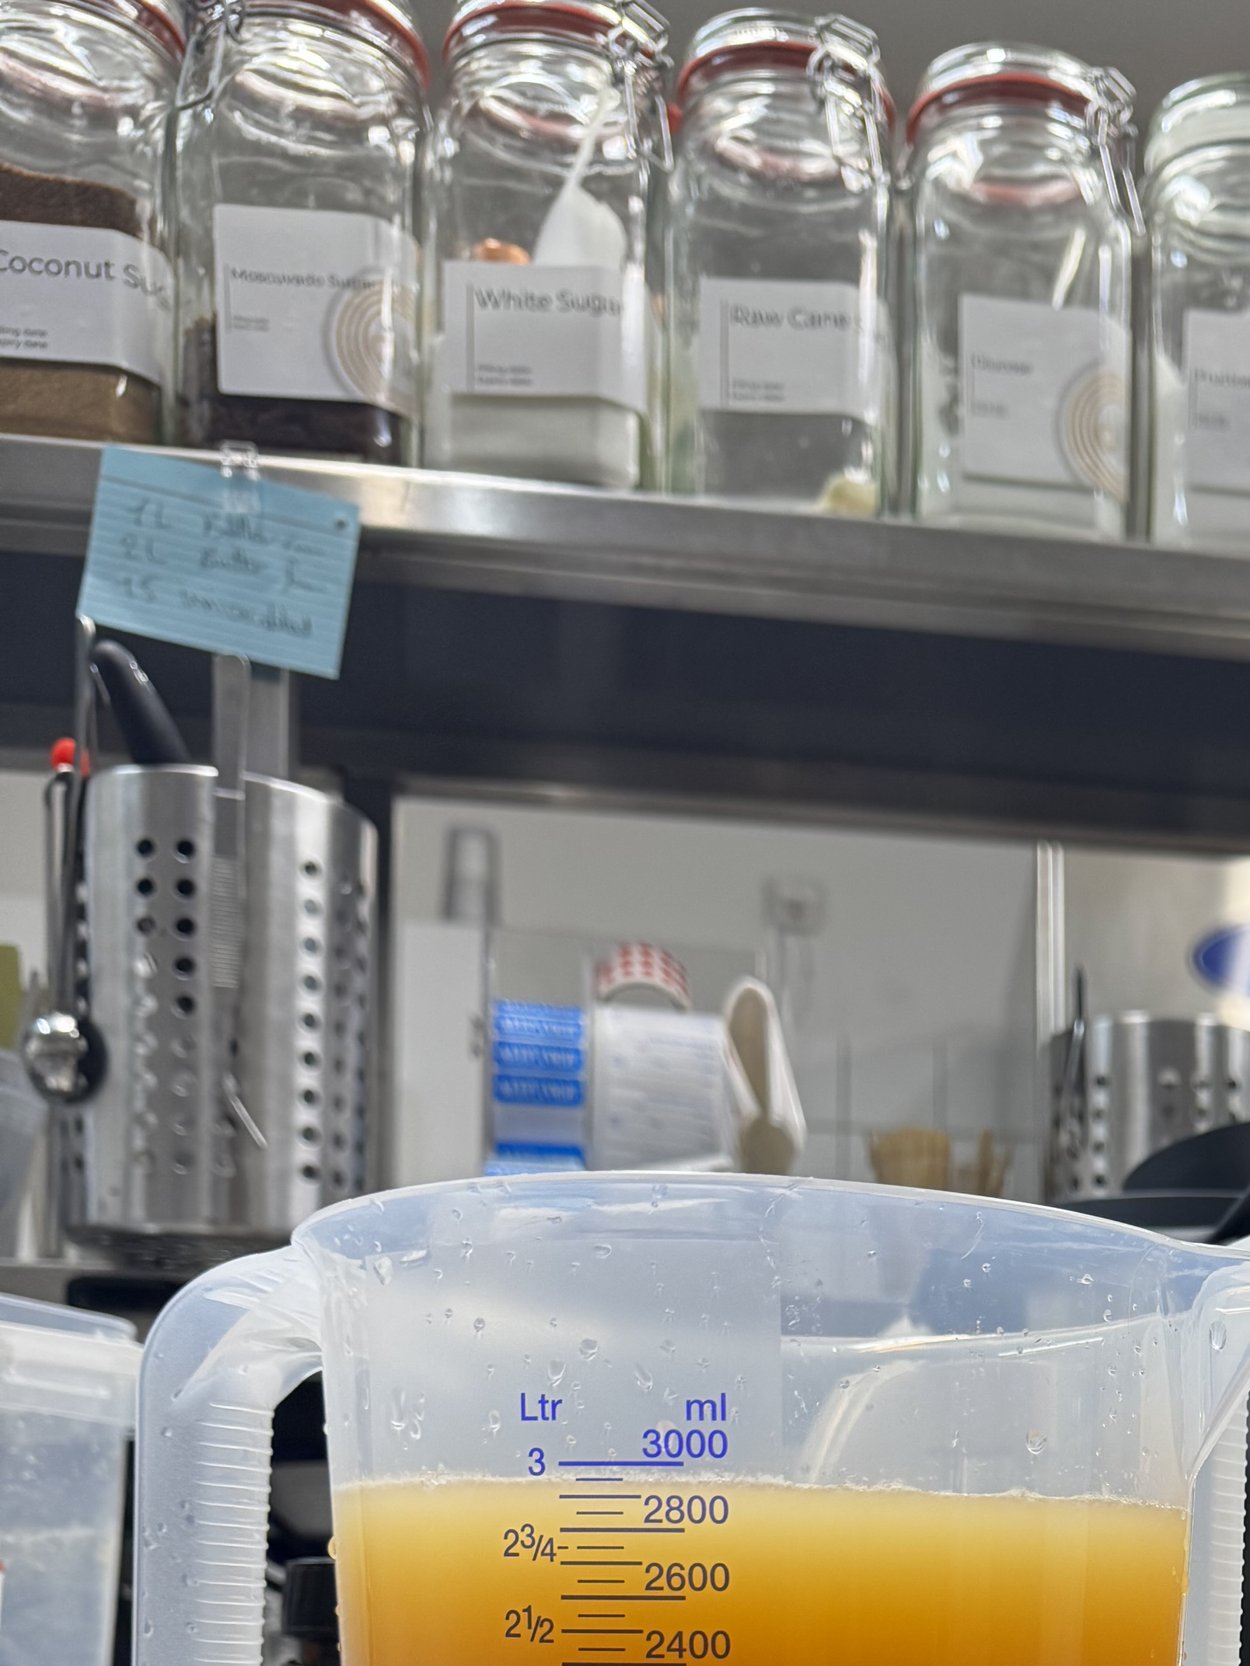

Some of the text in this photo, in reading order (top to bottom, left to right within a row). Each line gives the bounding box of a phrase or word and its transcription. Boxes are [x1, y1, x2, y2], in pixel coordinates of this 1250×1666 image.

[0, 249, 114, 280] Coconut
[475, 287, 551, 314] White
[520, 1392, 563, 1422] Ltr
[685, 1392, 727, 1422] ml
[642, 1429, 729, 1459] 3000
[528, 1447, 546, 1477] 3
[643, 1495, 729, 1524] 2800
[644, 1562, 731, 1592] 2600
[645, 1630, 731, 1659] 2400
